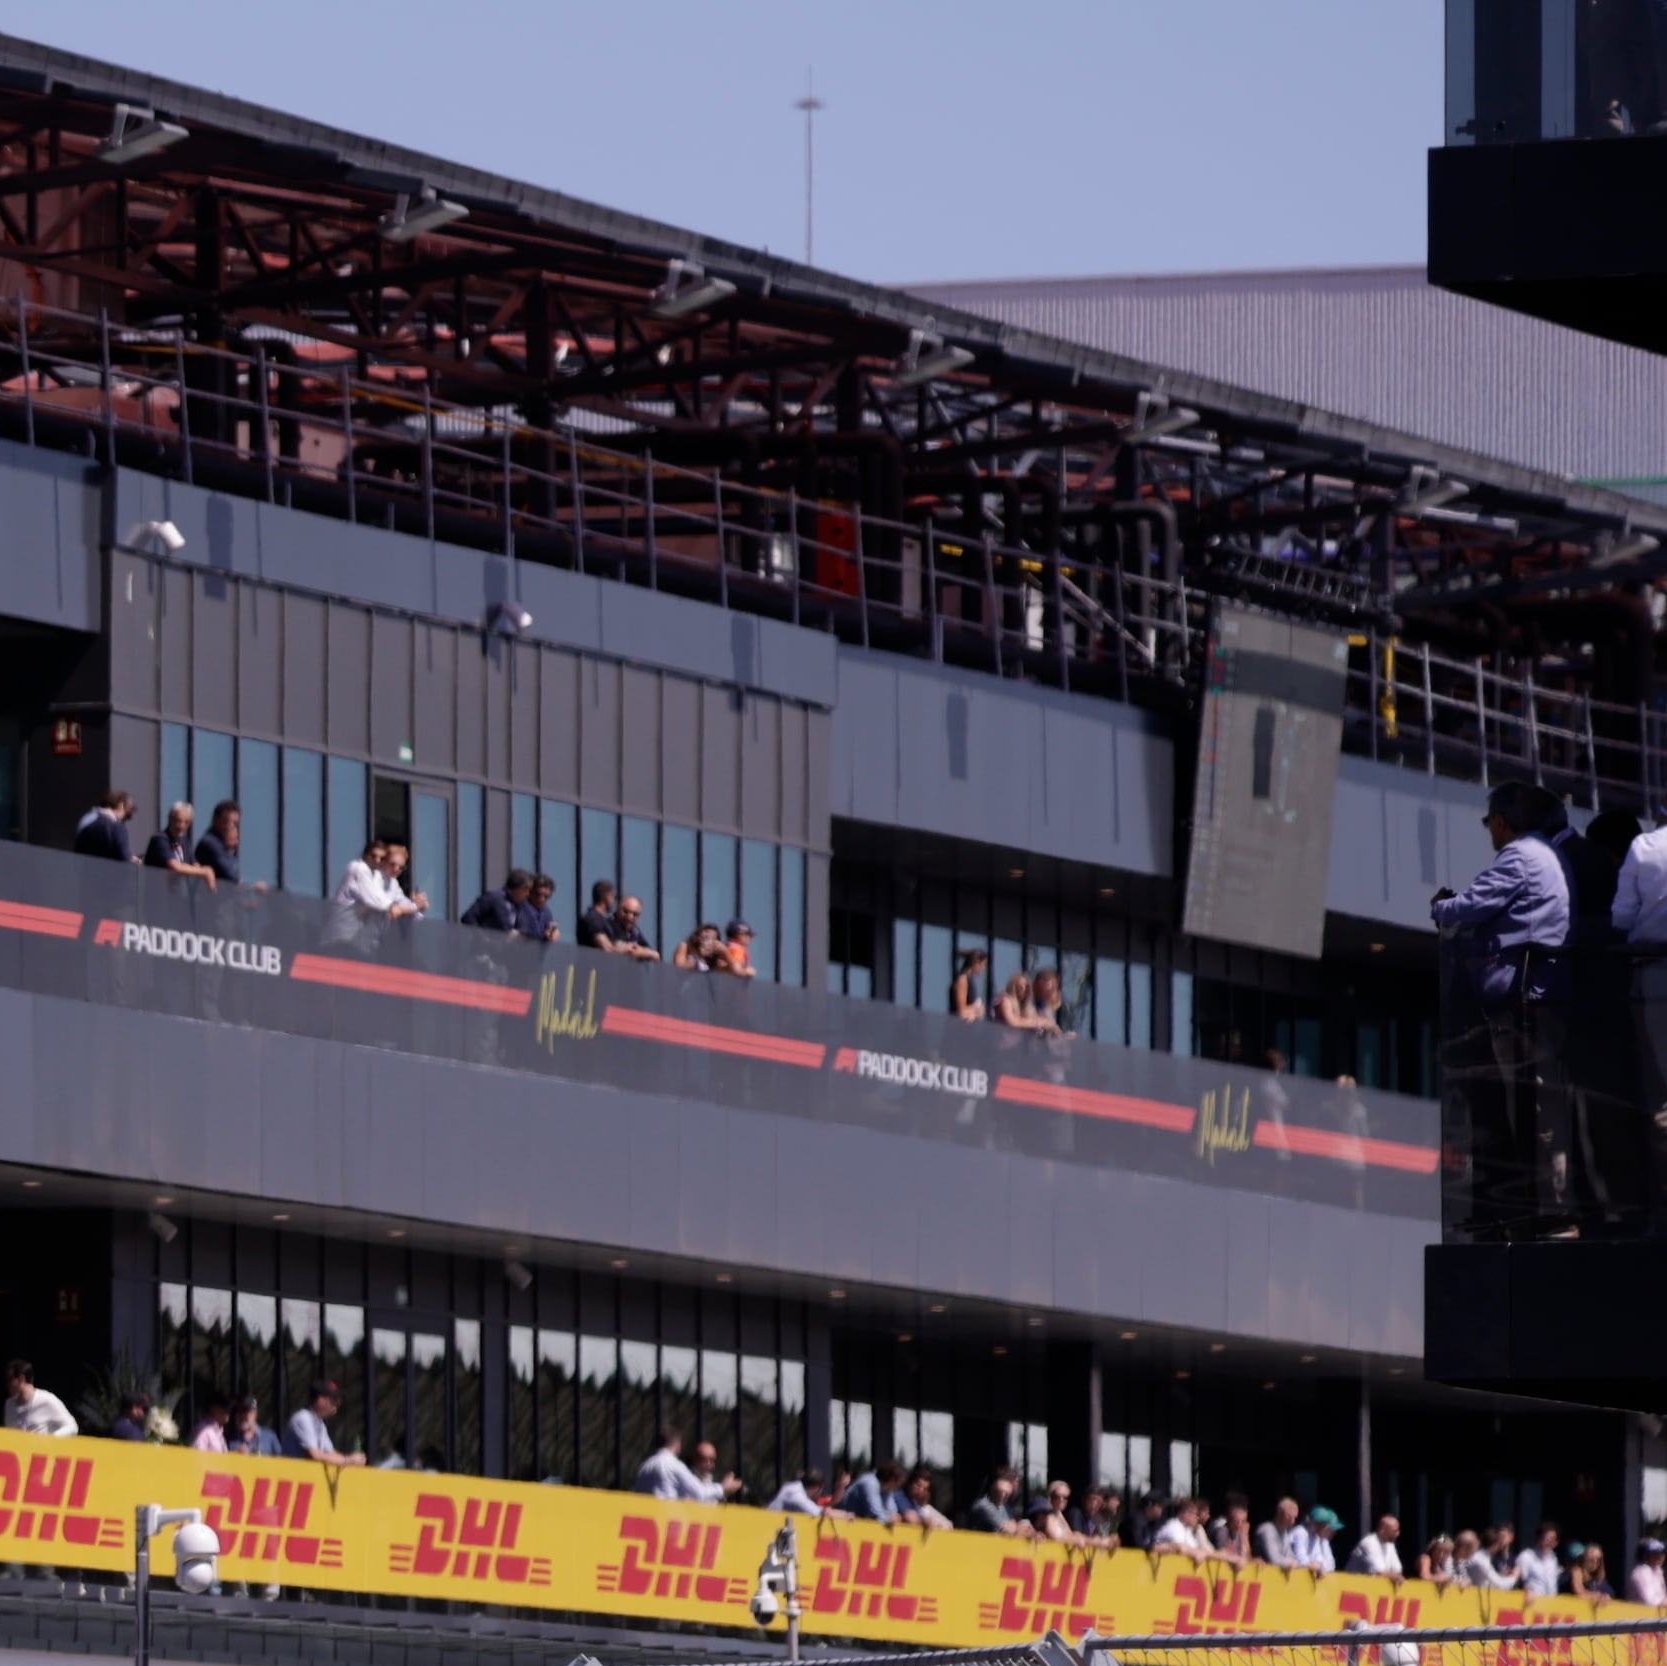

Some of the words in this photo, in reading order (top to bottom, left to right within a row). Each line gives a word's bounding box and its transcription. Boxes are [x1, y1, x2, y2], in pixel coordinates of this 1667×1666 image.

[123, 921, 226, 967] PADDOCK
[228, 939, 282, 976] CLUB
[536, 964, 598, 1053] Madrid
[857, 1050, 942, 1090] PADDOCK
[943, 1064, 988, 1098] CLUB
[1197, 1083, 1252, 1166] Madrid
[201, 1472, 322, 1565] DHL
[413, 1493, 532, 1583] DHL
[619, 1515, 729, 1603] DHL
[812, 1535, 920, 1621] DHL
[997, 1557, 1098, 1639] DHL
[1171, 1575, 1273, 1655] DHL
